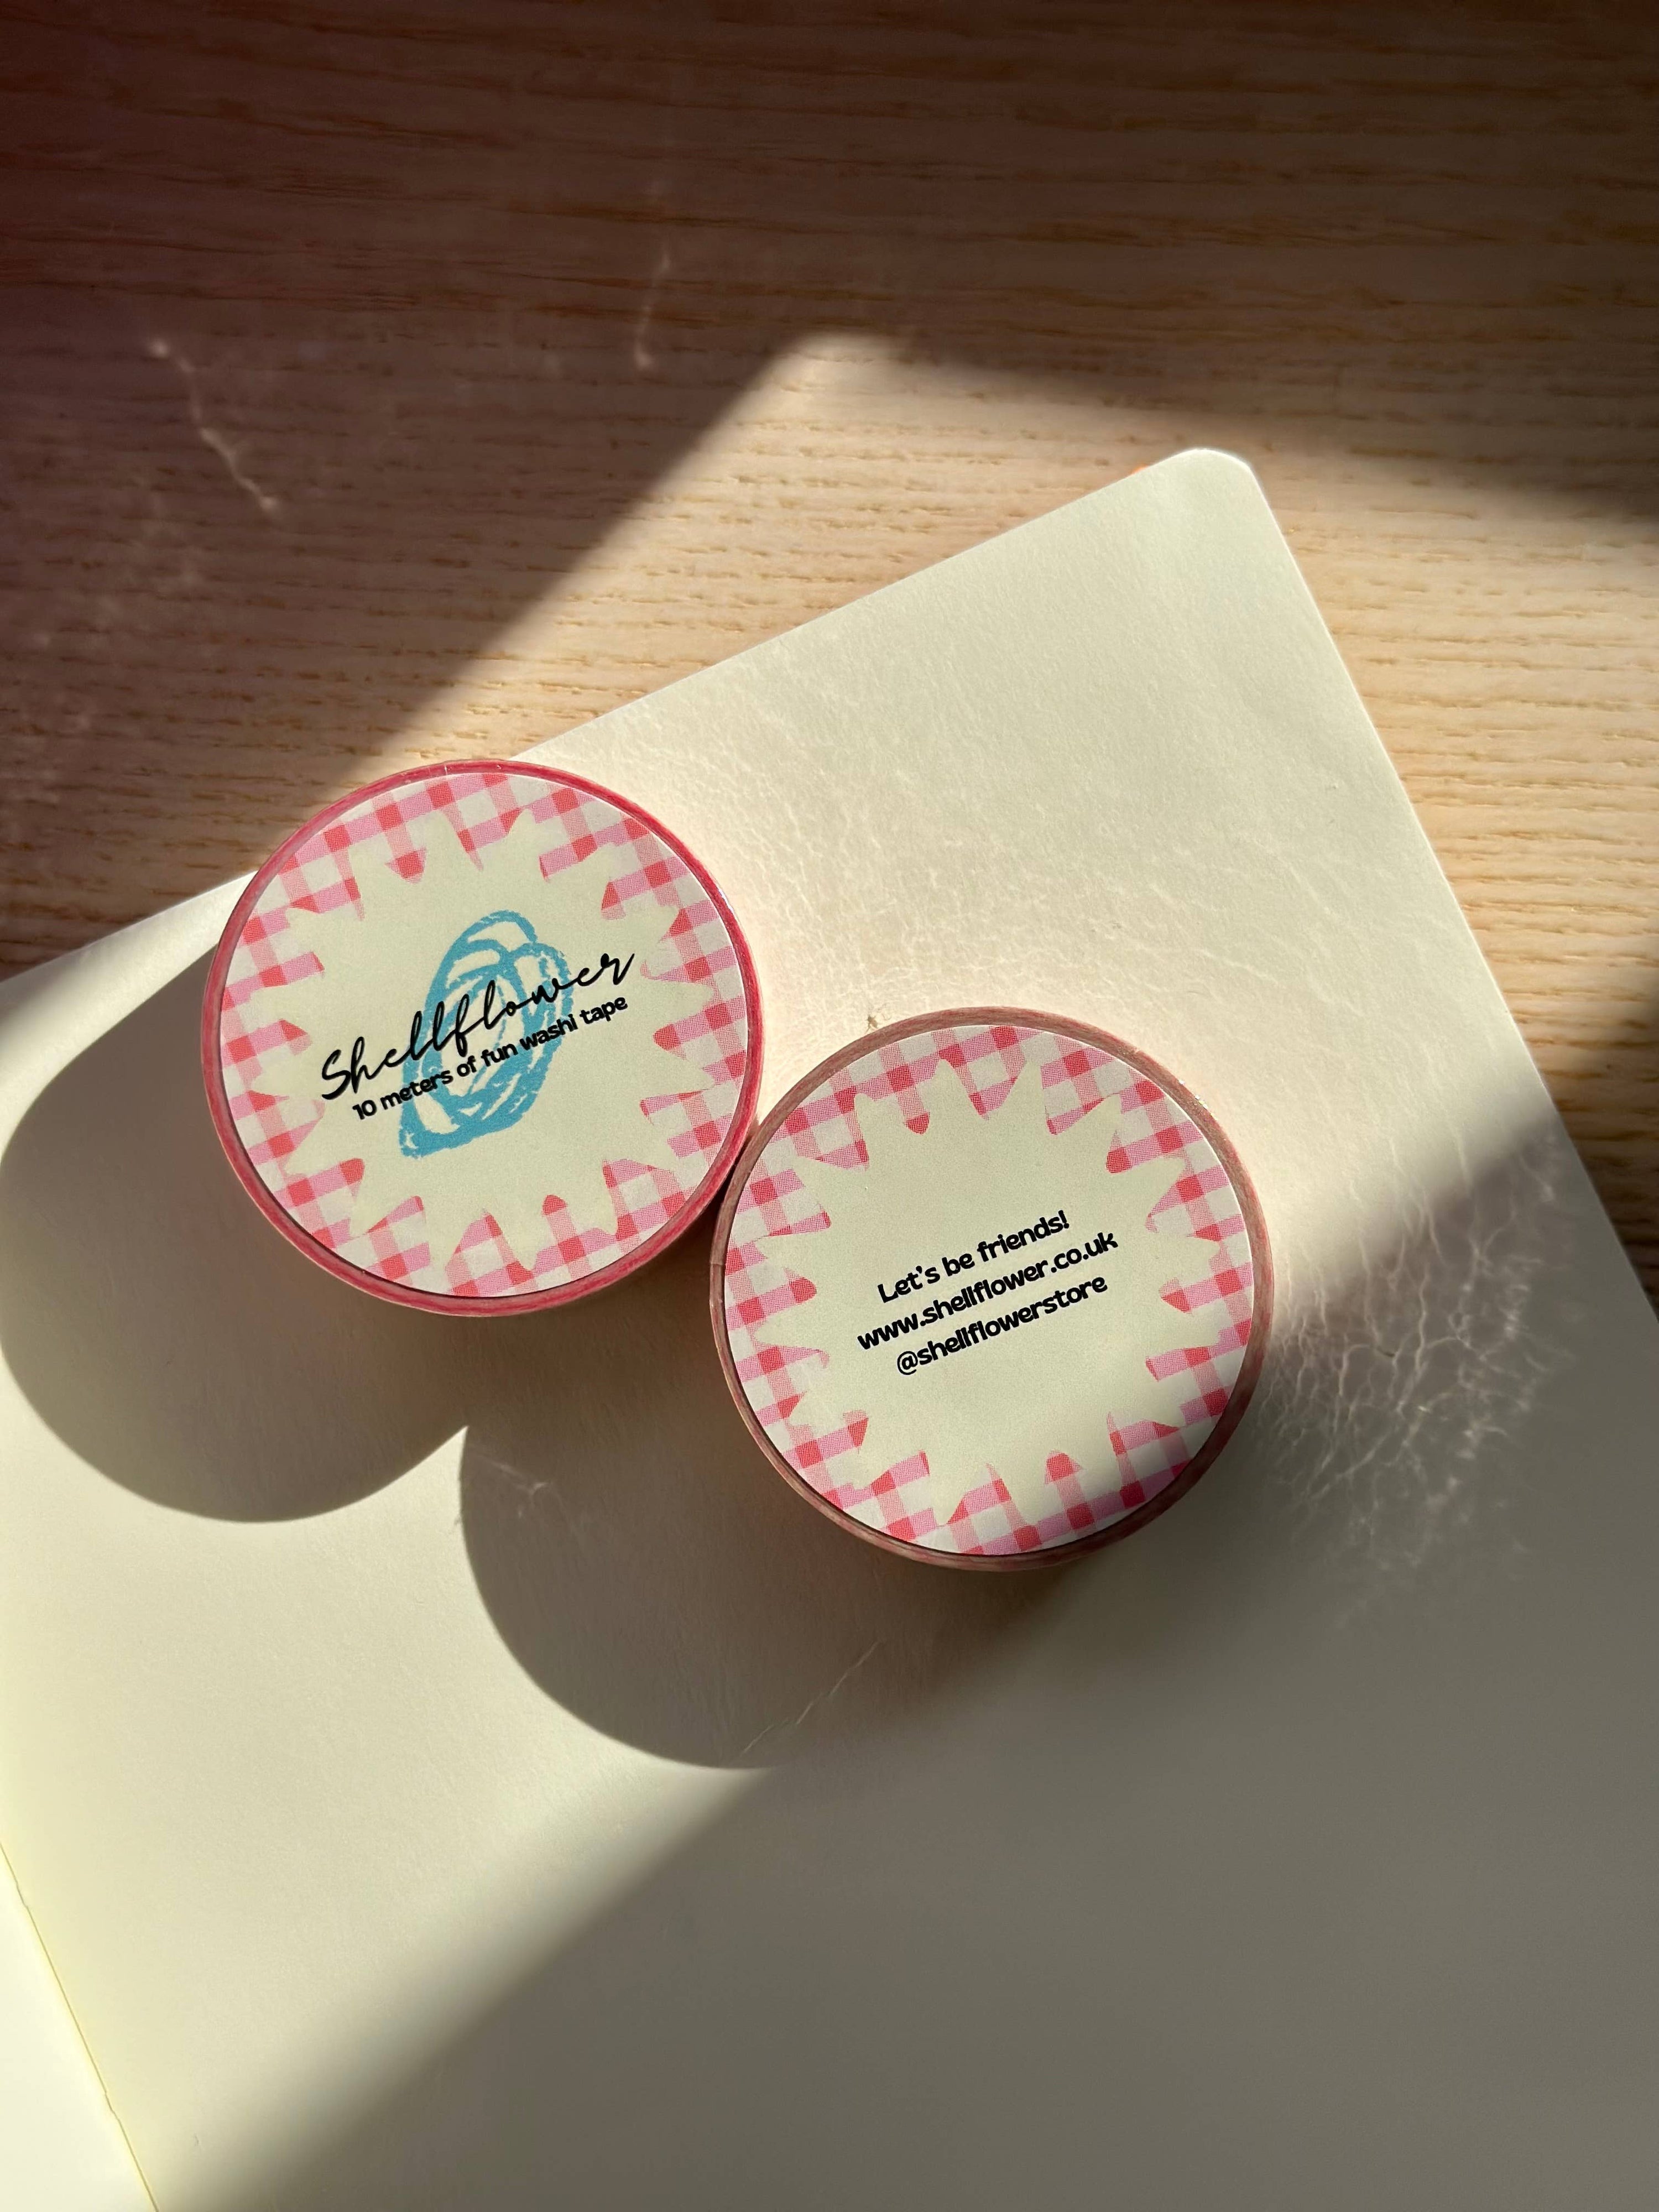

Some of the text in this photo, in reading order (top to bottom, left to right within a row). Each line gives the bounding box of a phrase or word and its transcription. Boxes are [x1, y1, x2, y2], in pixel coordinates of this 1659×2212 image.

[321, 952, 635, 1100] Shellflower
[352, 996, 628, 1120] 10 meters of fun washi tape
[857, 1232, 1118, 1349] www.shellflower.co.uk
[878, 1210, 1070, 1303] Let's be friends!
[897, 1276, 1108, 1375] @shellflowerstore
